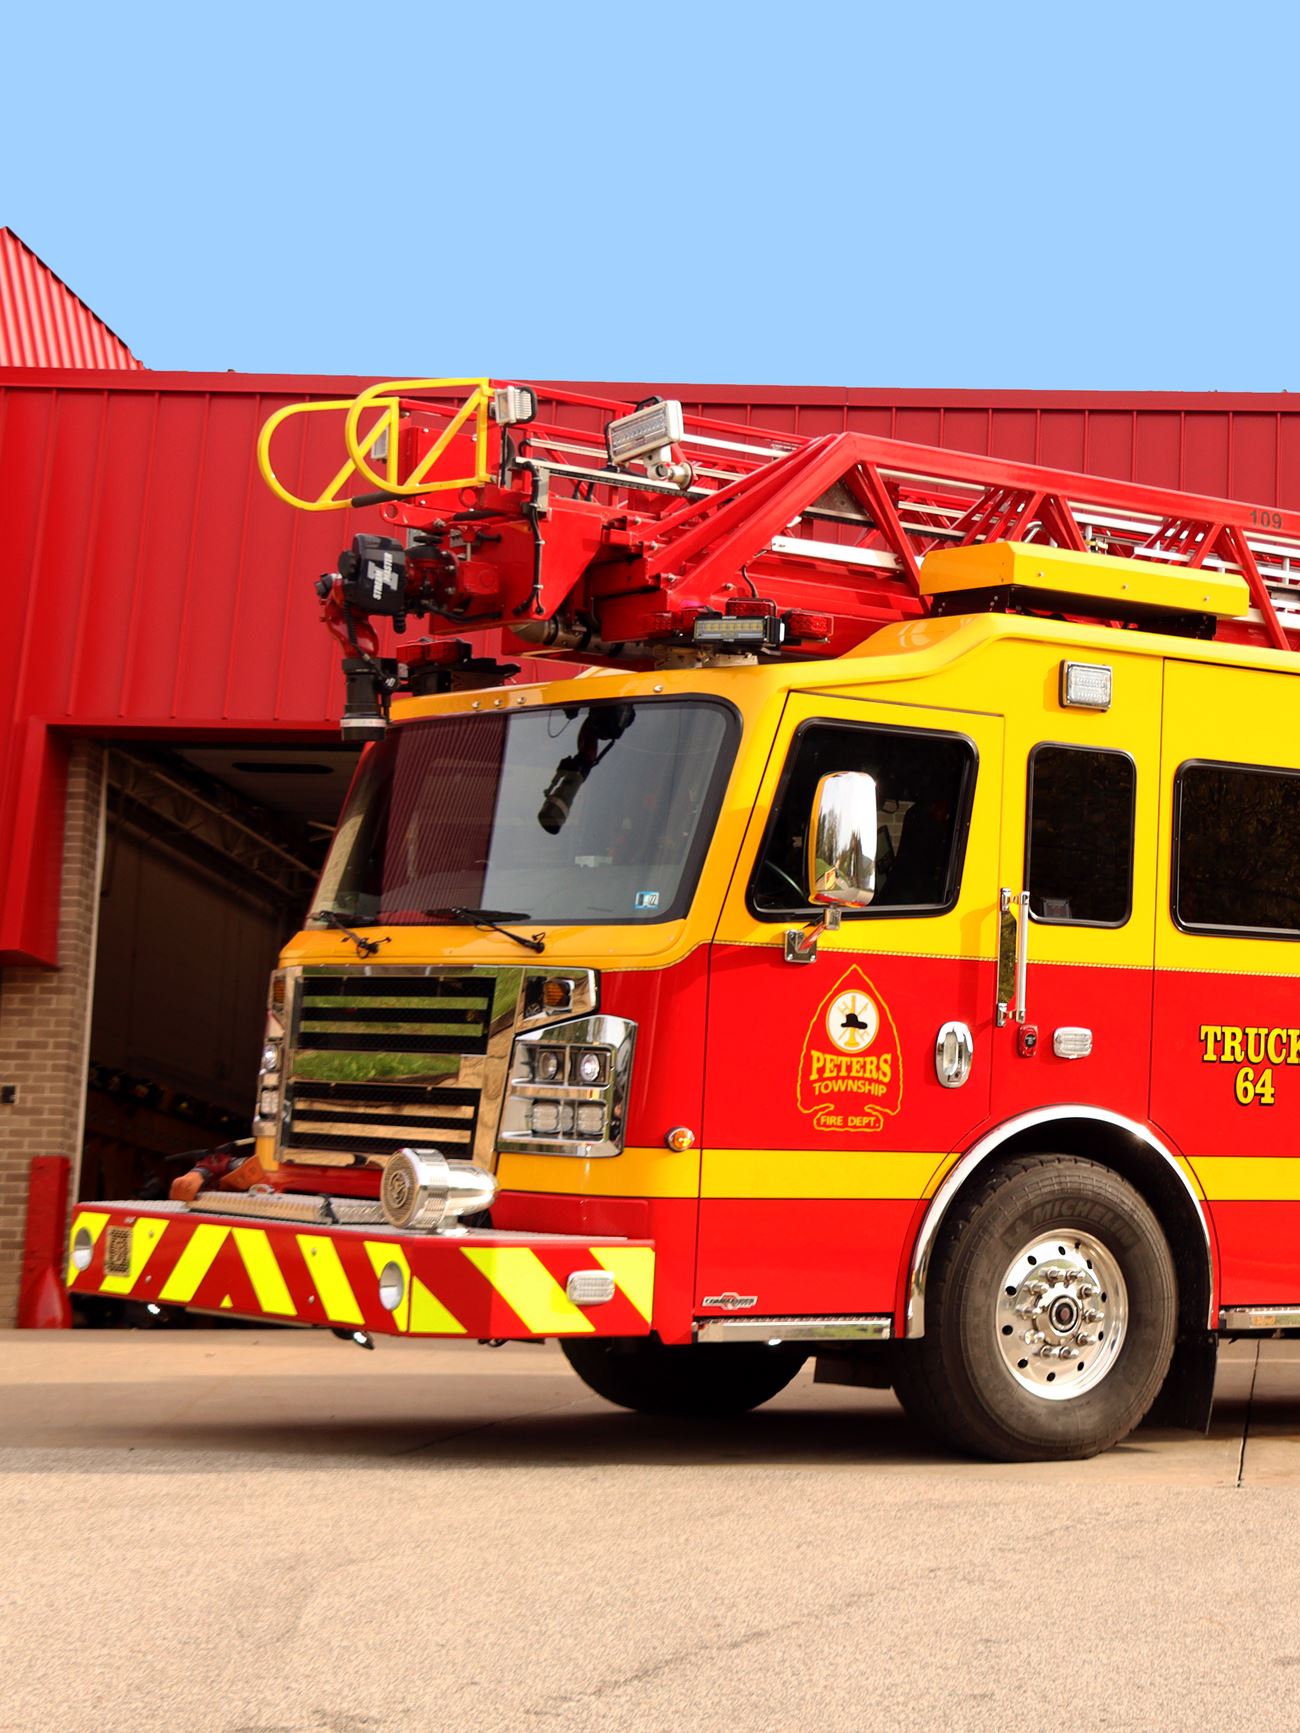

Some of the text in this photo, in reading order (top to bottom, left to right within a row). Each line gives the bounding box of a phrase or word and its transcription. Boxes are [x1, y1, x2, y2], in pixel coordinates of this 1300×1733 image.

[1250, 510, 1282, 530] 109
[809, 1049, 892, 1083] PETERS
[813, 1079, 887, 1097] TOWNSHIP
[1235, 1066, 1275, 1106] 64
[820, 1115, 880, 1127] FIRE DEPT.
[1032, 1200, 1141, 1250] MICHELIN
